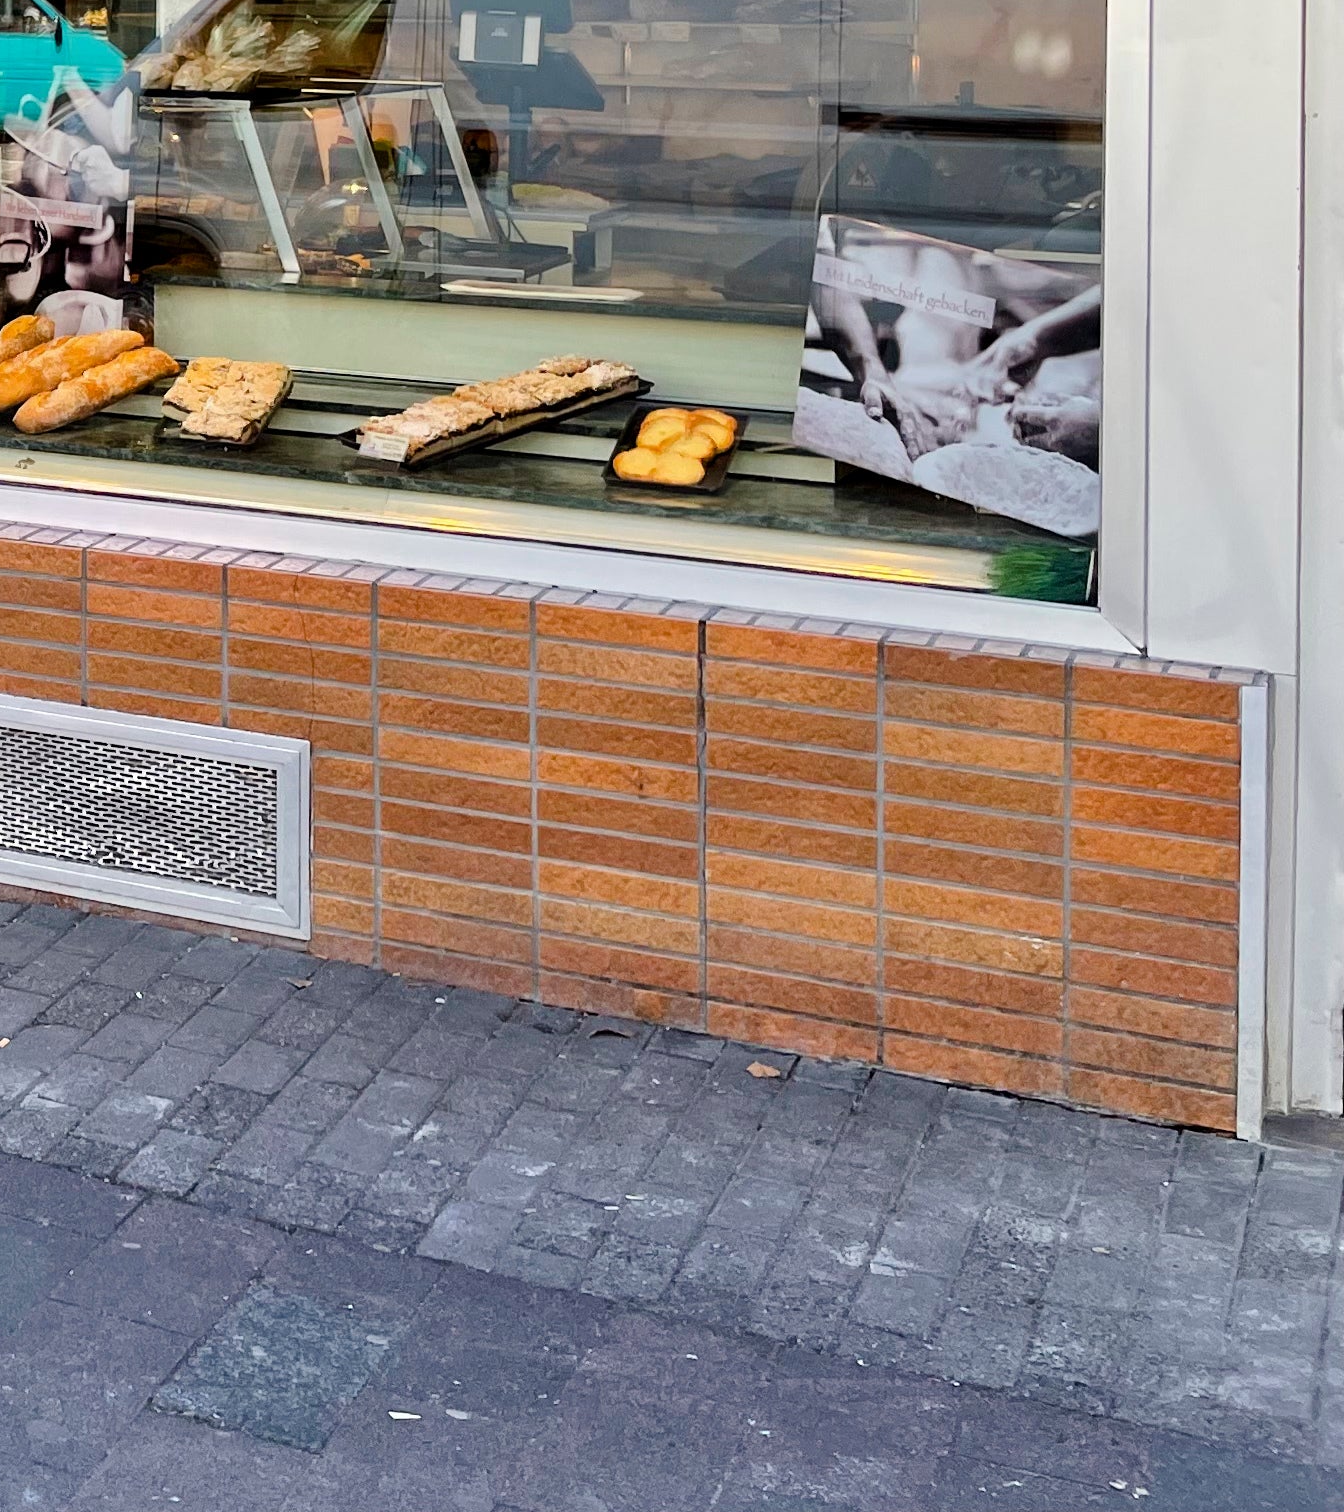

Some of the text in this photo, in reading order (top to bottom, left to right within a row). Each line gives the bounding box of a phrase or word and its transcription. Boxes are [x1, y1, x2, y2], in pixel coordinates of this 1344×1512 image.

[824, 267, 990, 321] Mit Leidenschaft gebacken.
